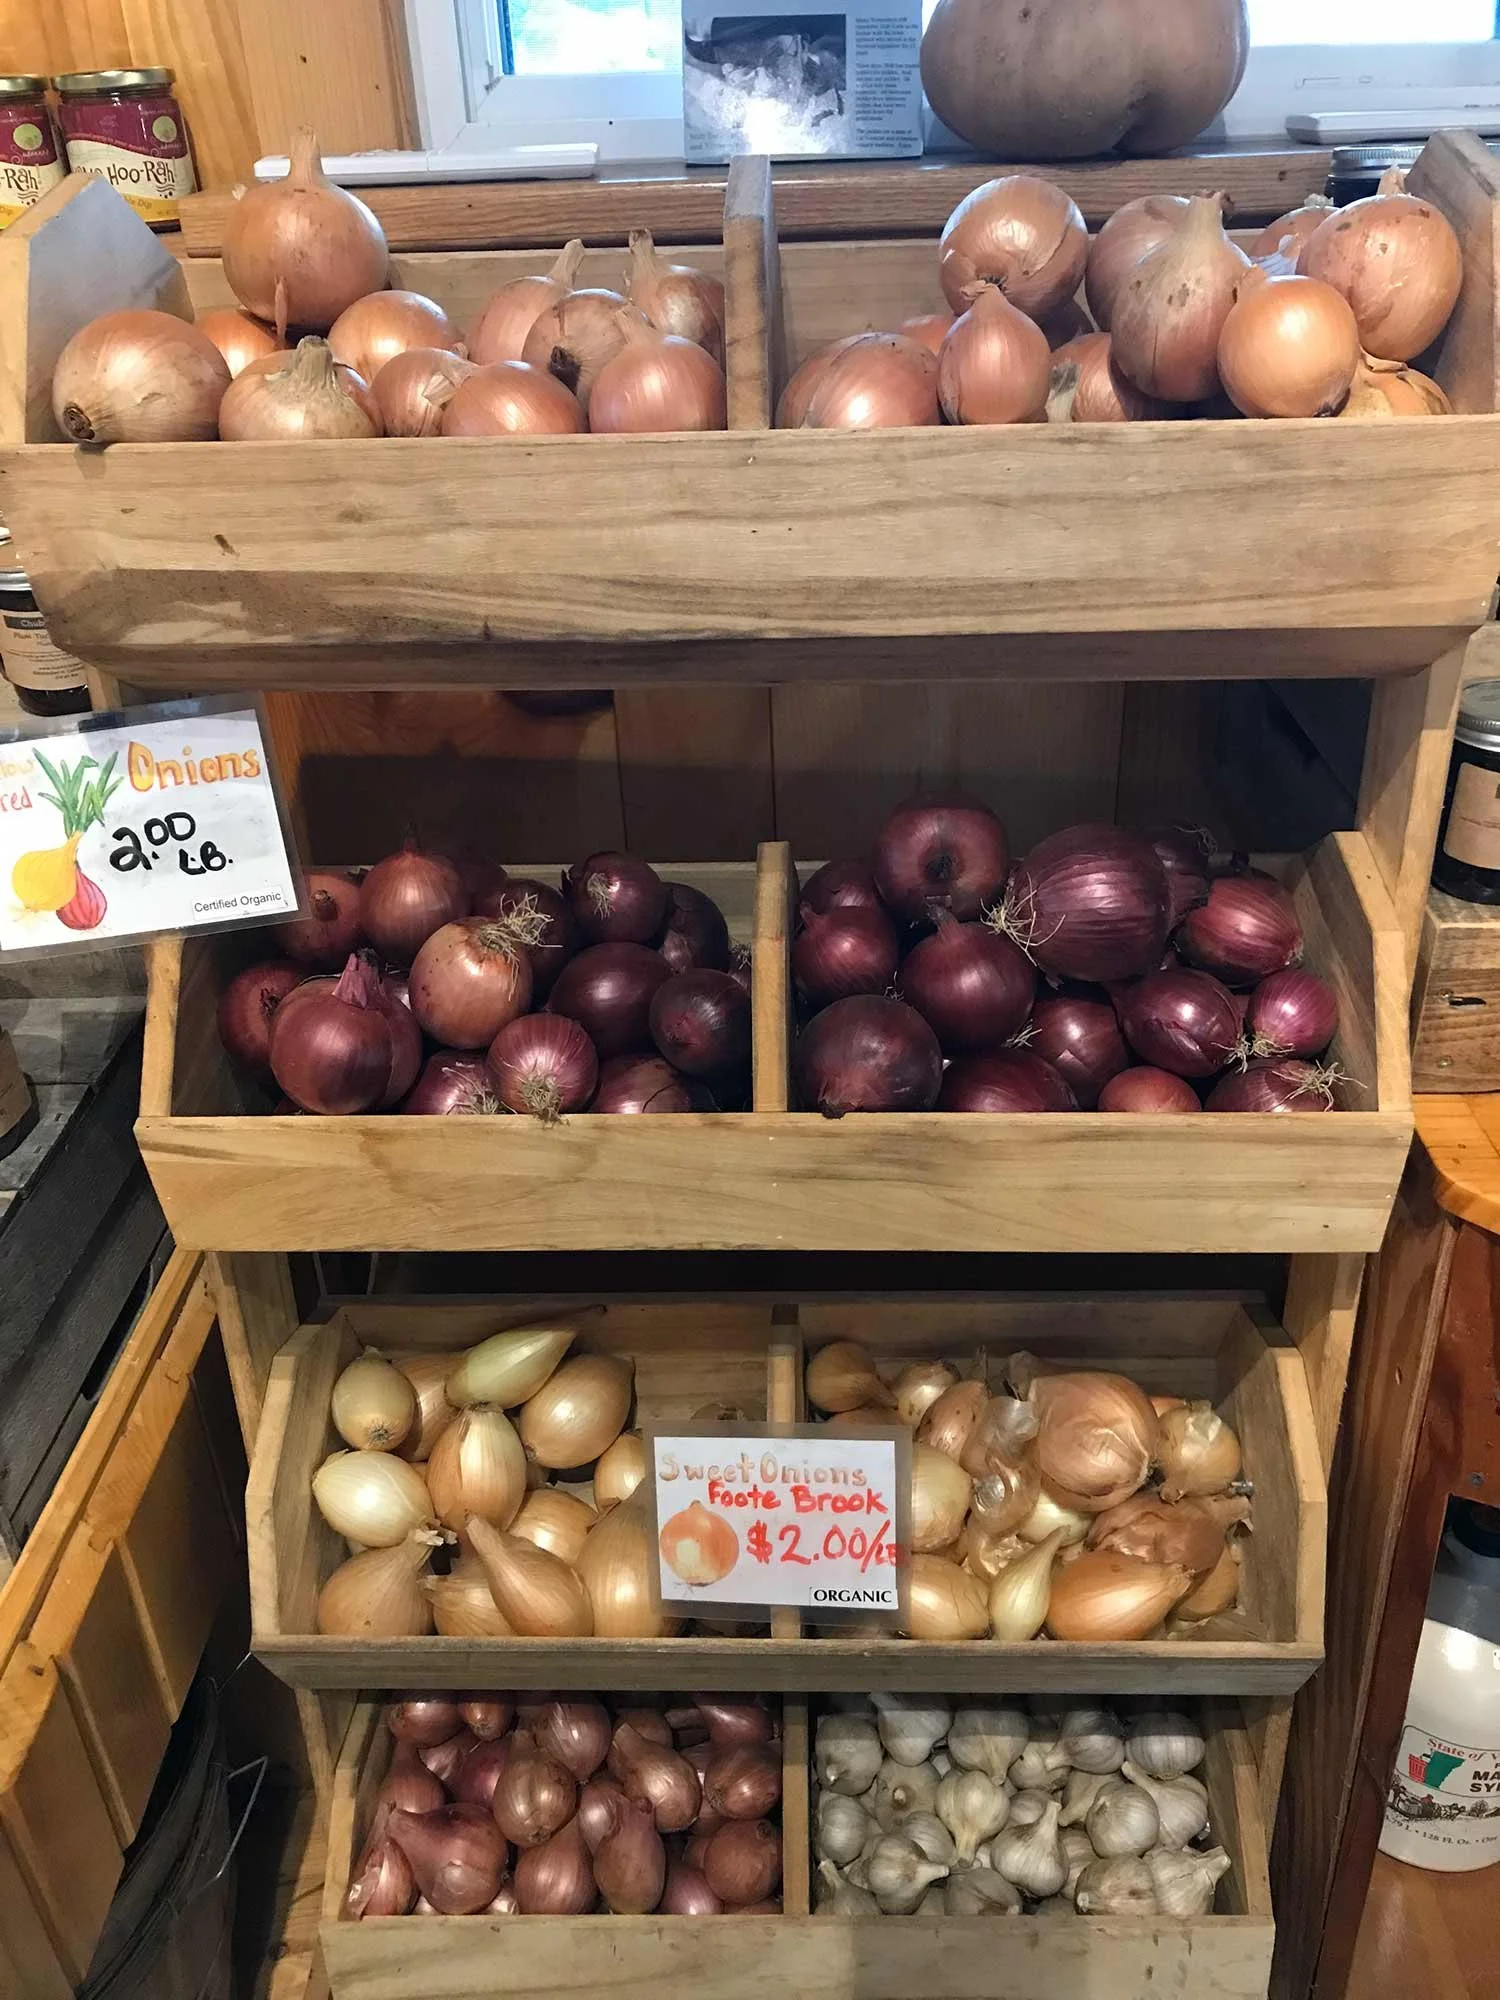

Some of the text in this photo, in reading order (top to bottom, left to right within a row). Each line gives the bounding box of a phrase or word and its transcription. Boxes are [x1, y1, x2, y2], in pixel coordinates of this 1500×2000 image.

[127, 741, 261, 793] Onions
[0, 785, 33, 812] red
[194, 890, 283, 914] Certified Organic
[658, 1451, 868, 1487] Sweet Onions
[707, 1480, 889, 1515] Foote Brook
[813, 1588, 892, 1603] ORGANIC
[1427, 1739, 1465, 1757] State
[1468, 1750, 1487, 1762] of
